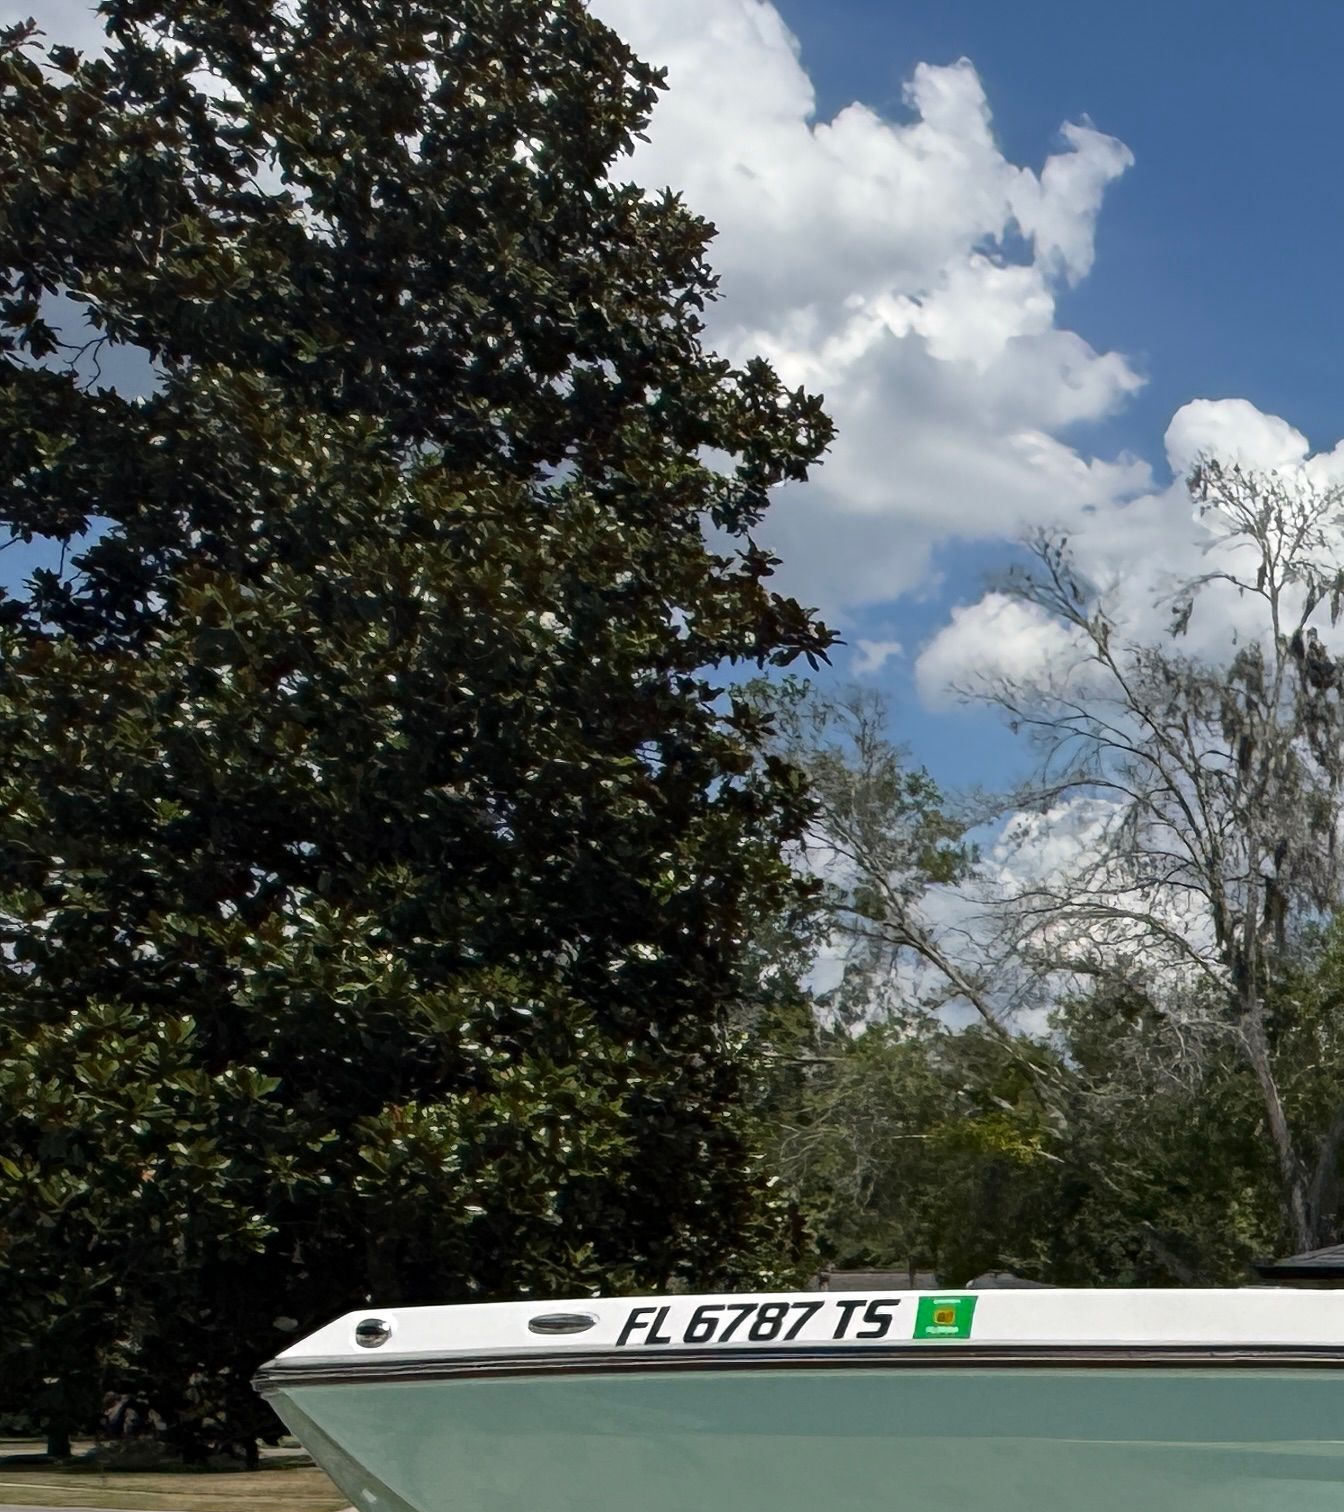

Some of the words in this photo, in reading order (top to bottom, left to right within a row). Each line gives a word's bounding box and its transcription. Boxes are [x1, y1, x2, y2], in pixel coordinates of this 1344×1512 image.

[616, 1306, 671, 1346] FL
[683, 1301, 824, 1343] 6787
[832, 1299, 900, 1339] TS
